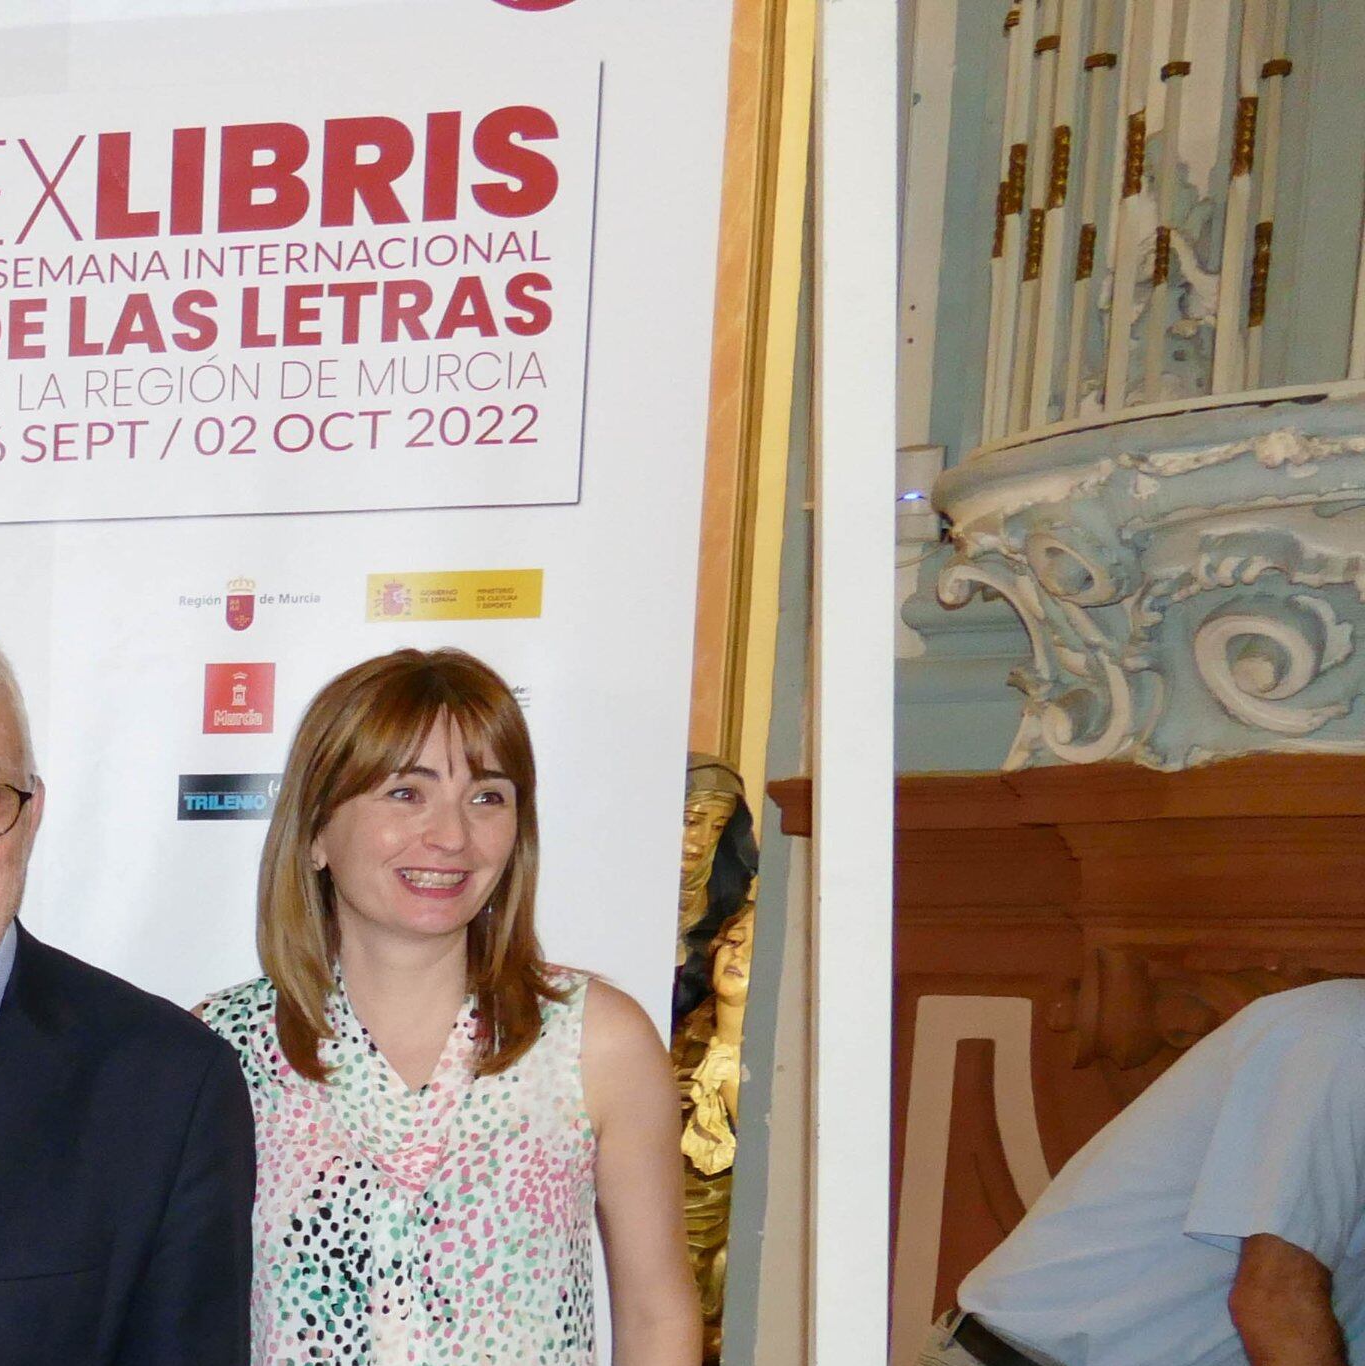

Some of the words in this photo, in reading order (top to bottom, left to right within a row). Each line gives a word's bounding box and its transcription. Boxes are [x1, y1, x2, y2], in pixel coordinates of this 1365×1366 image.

[183, 230, 552, 280] INTERNACIONAL
[68, 288, 219, 358] LAS
[240, 271, 554, 350] LETRAS
[18, 373, 66, 411] LA
[85, 354, 260, 409] REGIÓN
[280, 359, 339, 400] DE
[357, 351, 548, 397] MURCIA
[21, 420, 149, 463] SEPT
[194, 415, 258, 457] 02
[273, 410, 391, 453] OCT
[405, 403, 540, 449] 2022
[179, 595, 222, 609] Región
[259, 594, 275, 605] de
[278, 592, 322, 604] Murcia
[213, 709, 263, 727] Murcia
